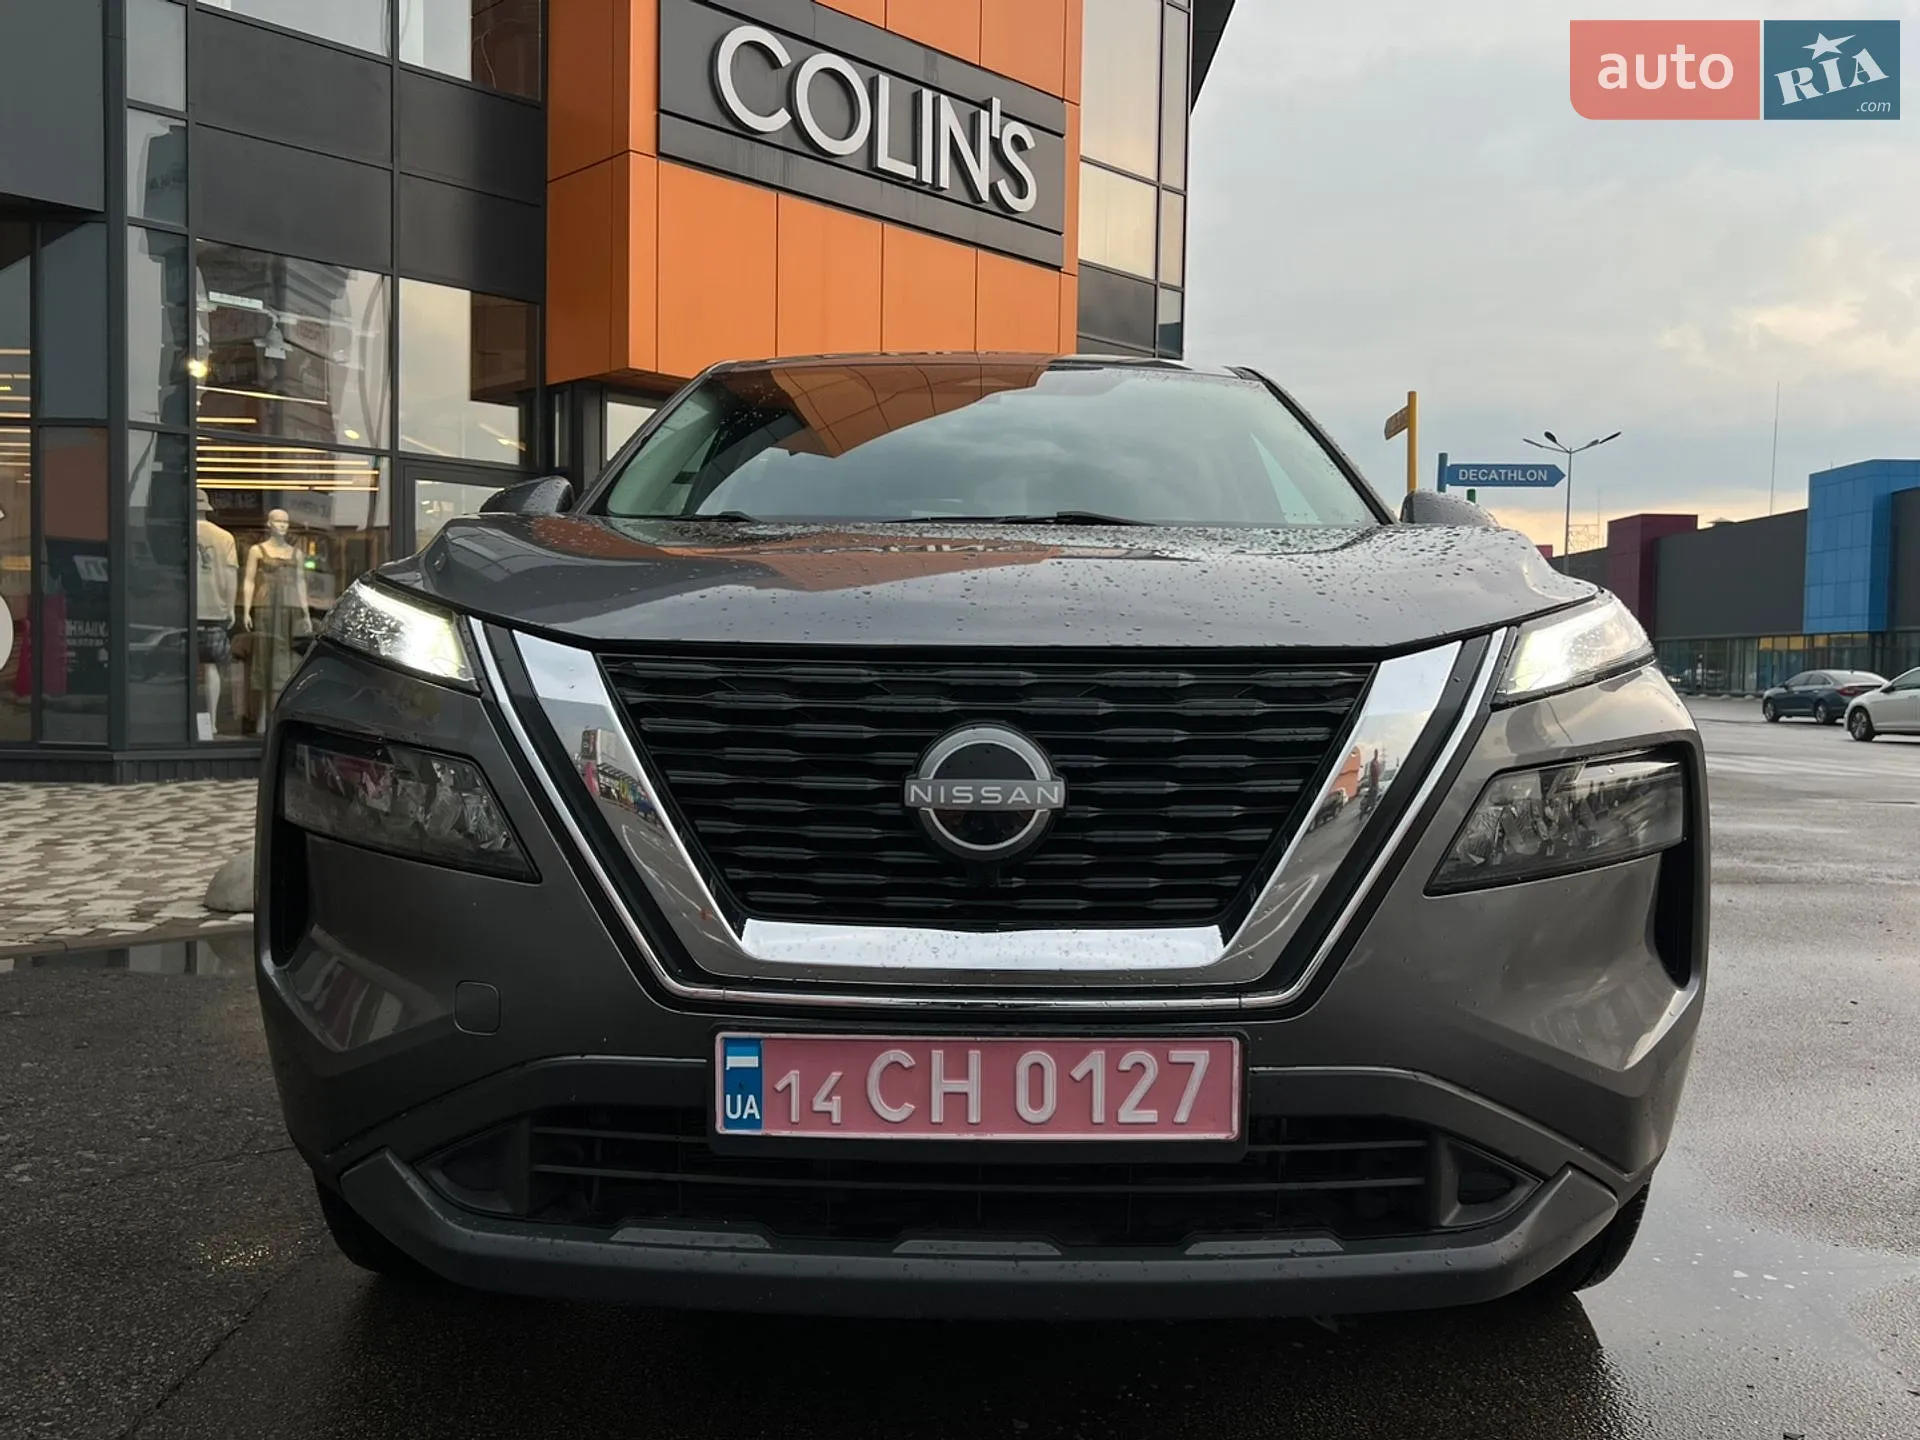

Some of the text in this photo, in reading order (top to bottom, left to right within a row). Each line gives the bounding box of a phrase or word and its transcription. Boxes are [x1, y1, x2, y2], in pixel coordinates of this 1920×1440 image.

[715, 25, 1038, 214] COLIN'S
[1458, 468, 1548, 482] DECATHLON
[910, 784, 1060, 805] NISSAN
[774, 1049, 1210, 1124] 14 CH 0127
[724, 1094, 760, 1120] UA
